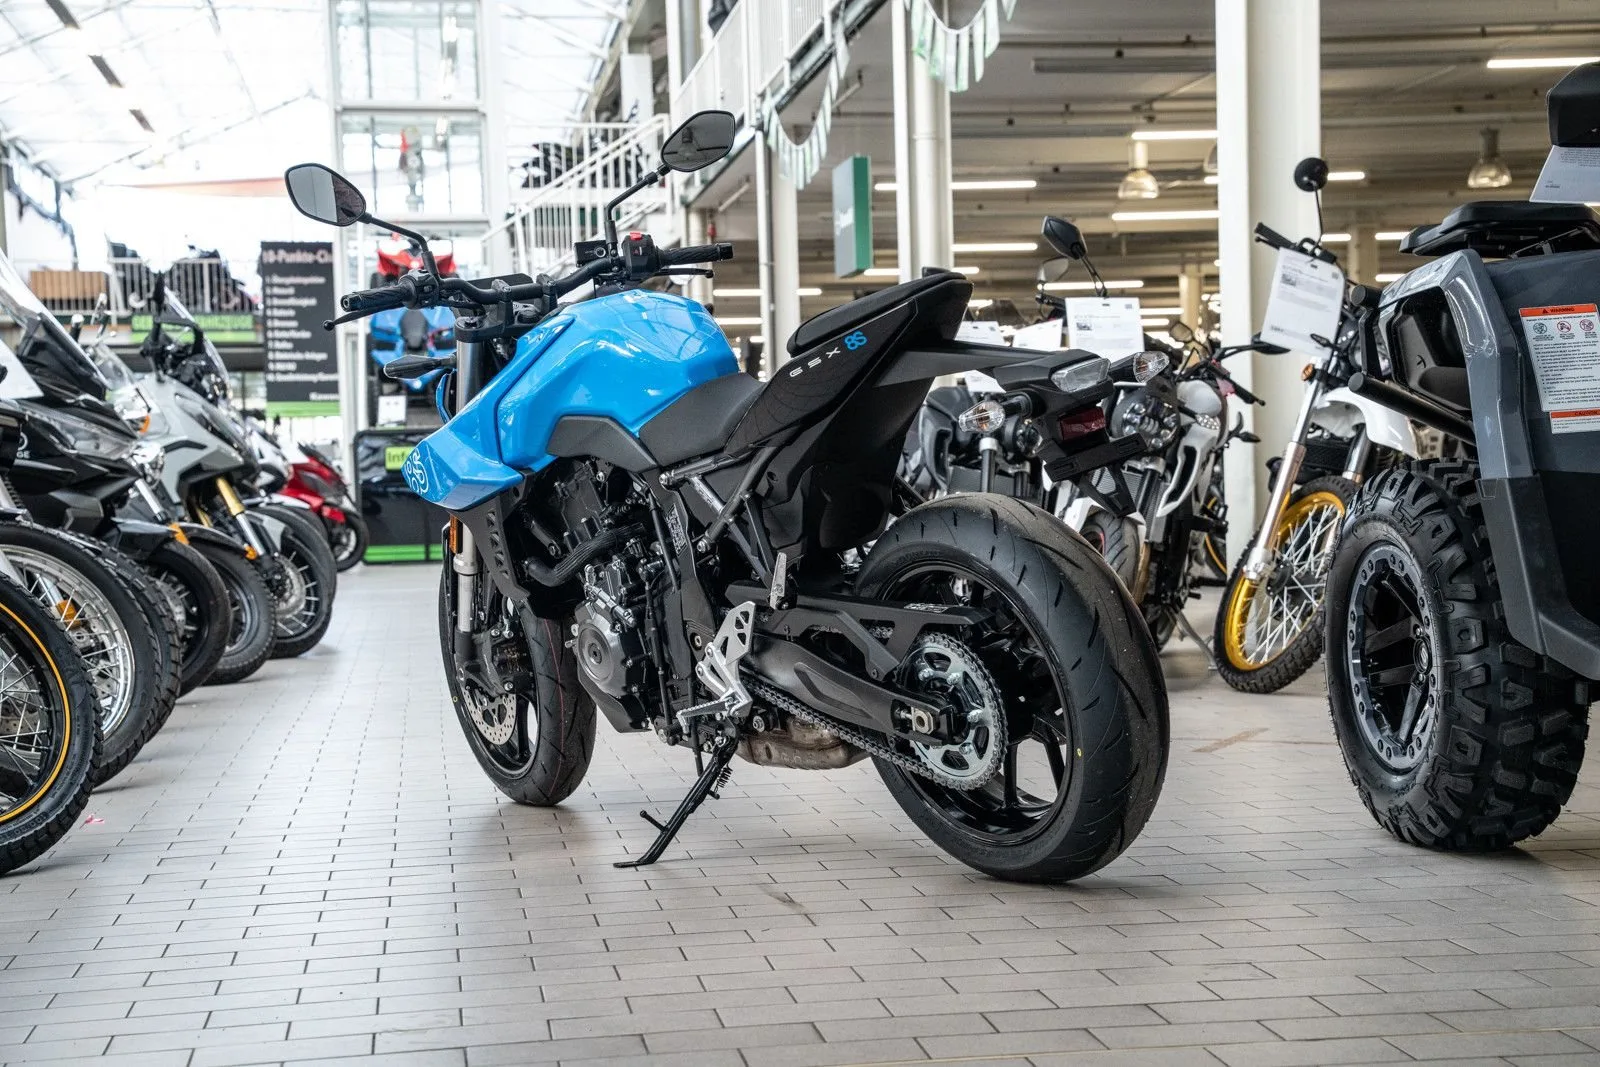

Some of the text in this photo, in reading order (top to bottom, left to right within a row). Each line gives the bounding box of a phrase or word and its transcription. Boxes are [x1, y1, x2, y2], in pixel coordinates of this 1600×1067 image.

[789, 331, 868, 377] GSX 8S
[387, 451, 406, 463] inf
